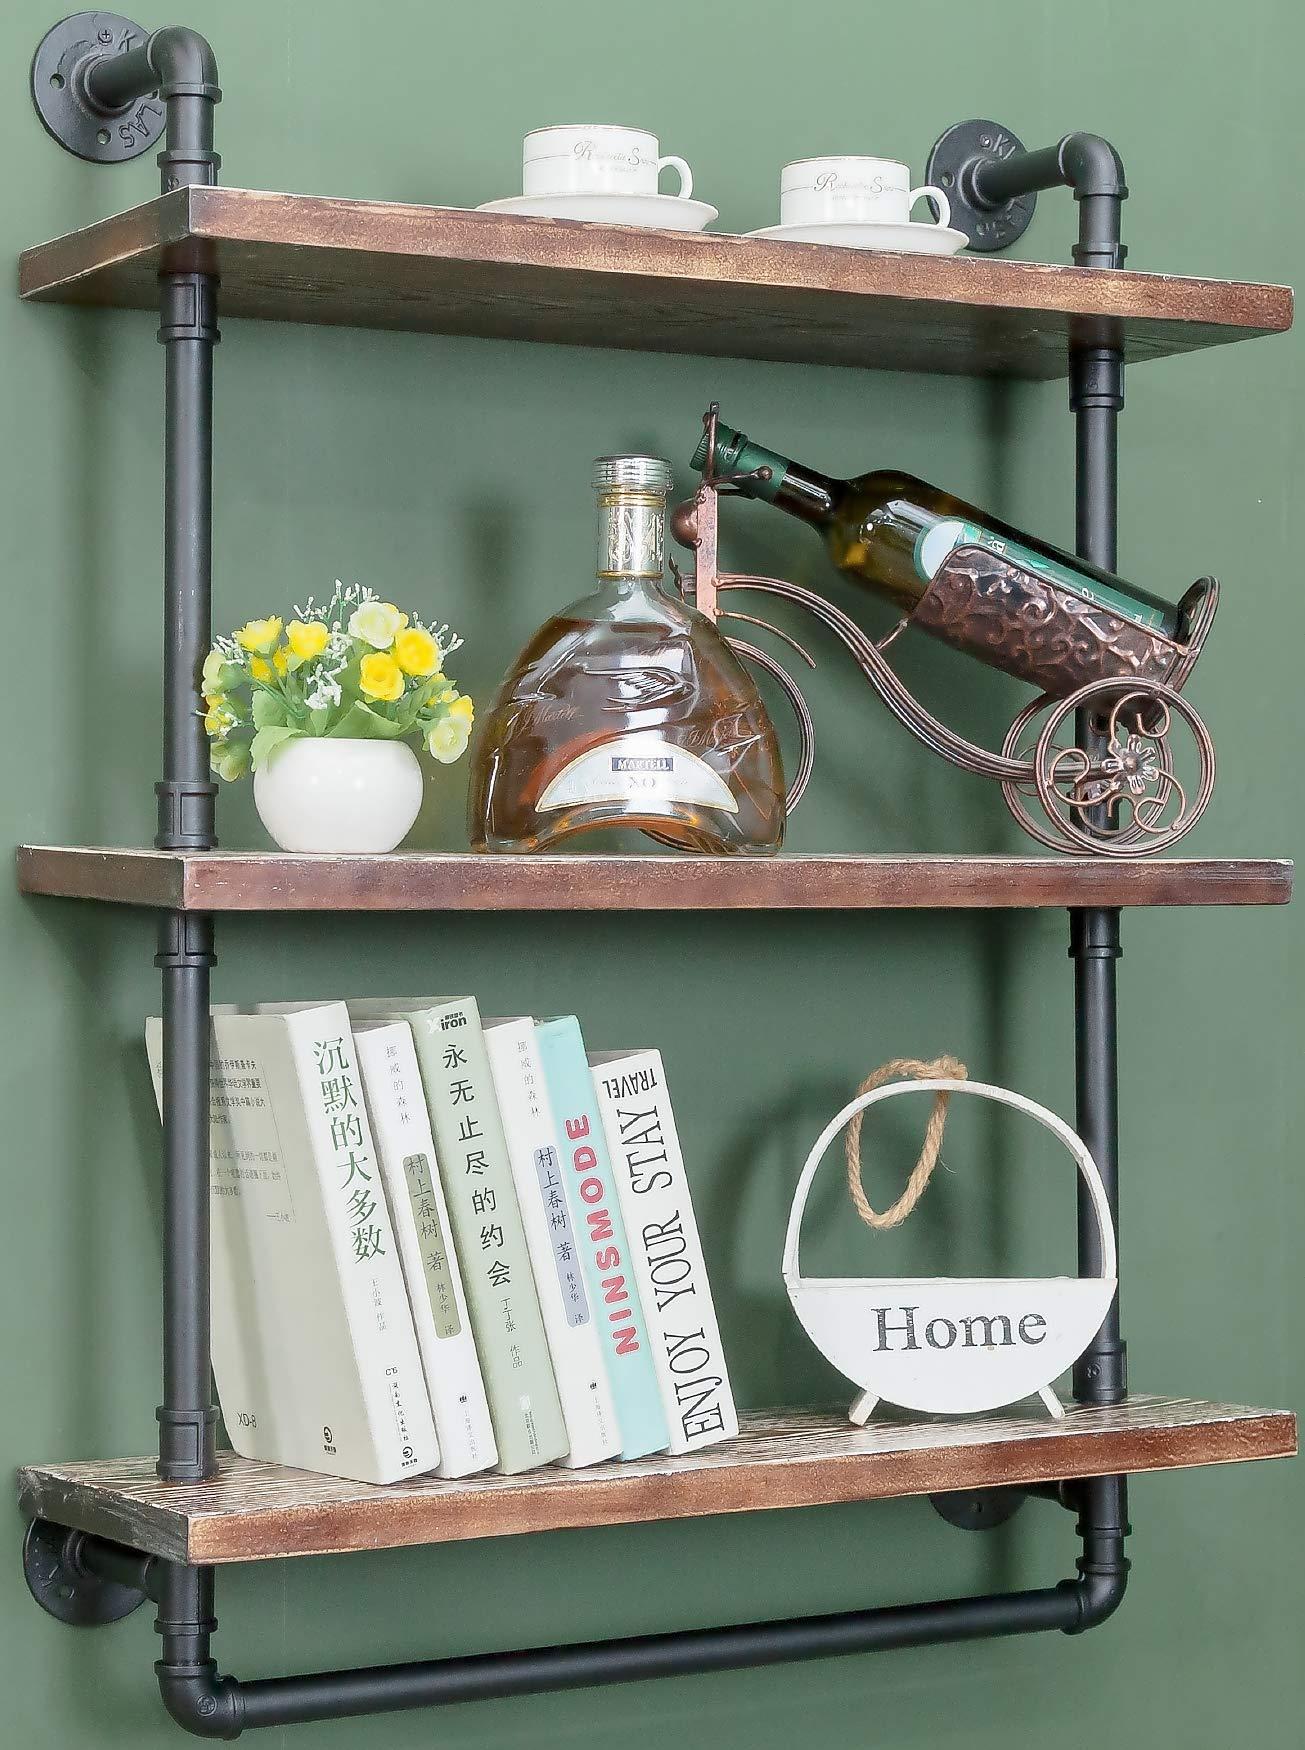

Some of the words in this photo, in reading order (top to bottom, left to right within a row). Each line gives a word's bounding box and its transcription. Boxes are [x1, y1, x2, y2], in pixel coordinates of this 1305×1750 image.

[440, 1016, 467, 1030] iron
[602, 1068, 658, 1099] TRAVEL
[313, 1037, 386, 1264] 沉默的大多数
[442, 1044, 512, 1288] 永无止尽的约会
[616, 1105, 673, 1194] STAY
[406, 1155, 438, 1240] 村上春树
[427, 1251, 445, 1272] 著
[537, 1147, 568, 1232] 村上春树
[556, 1241, 573, 1263] 著
[565, 1114, 640, 1356] NINSMODE
[642, 1209, 696, 1313] YOUR
[500, 1297, 516, 1333] 丁丁张
[510, 1344, 523, 1369] 作品
[871, 1306, 1047, 1352] Home
[237, 1412, 257, 1428] XD-8
[663, 1327, 725, 1442] ENJOY
